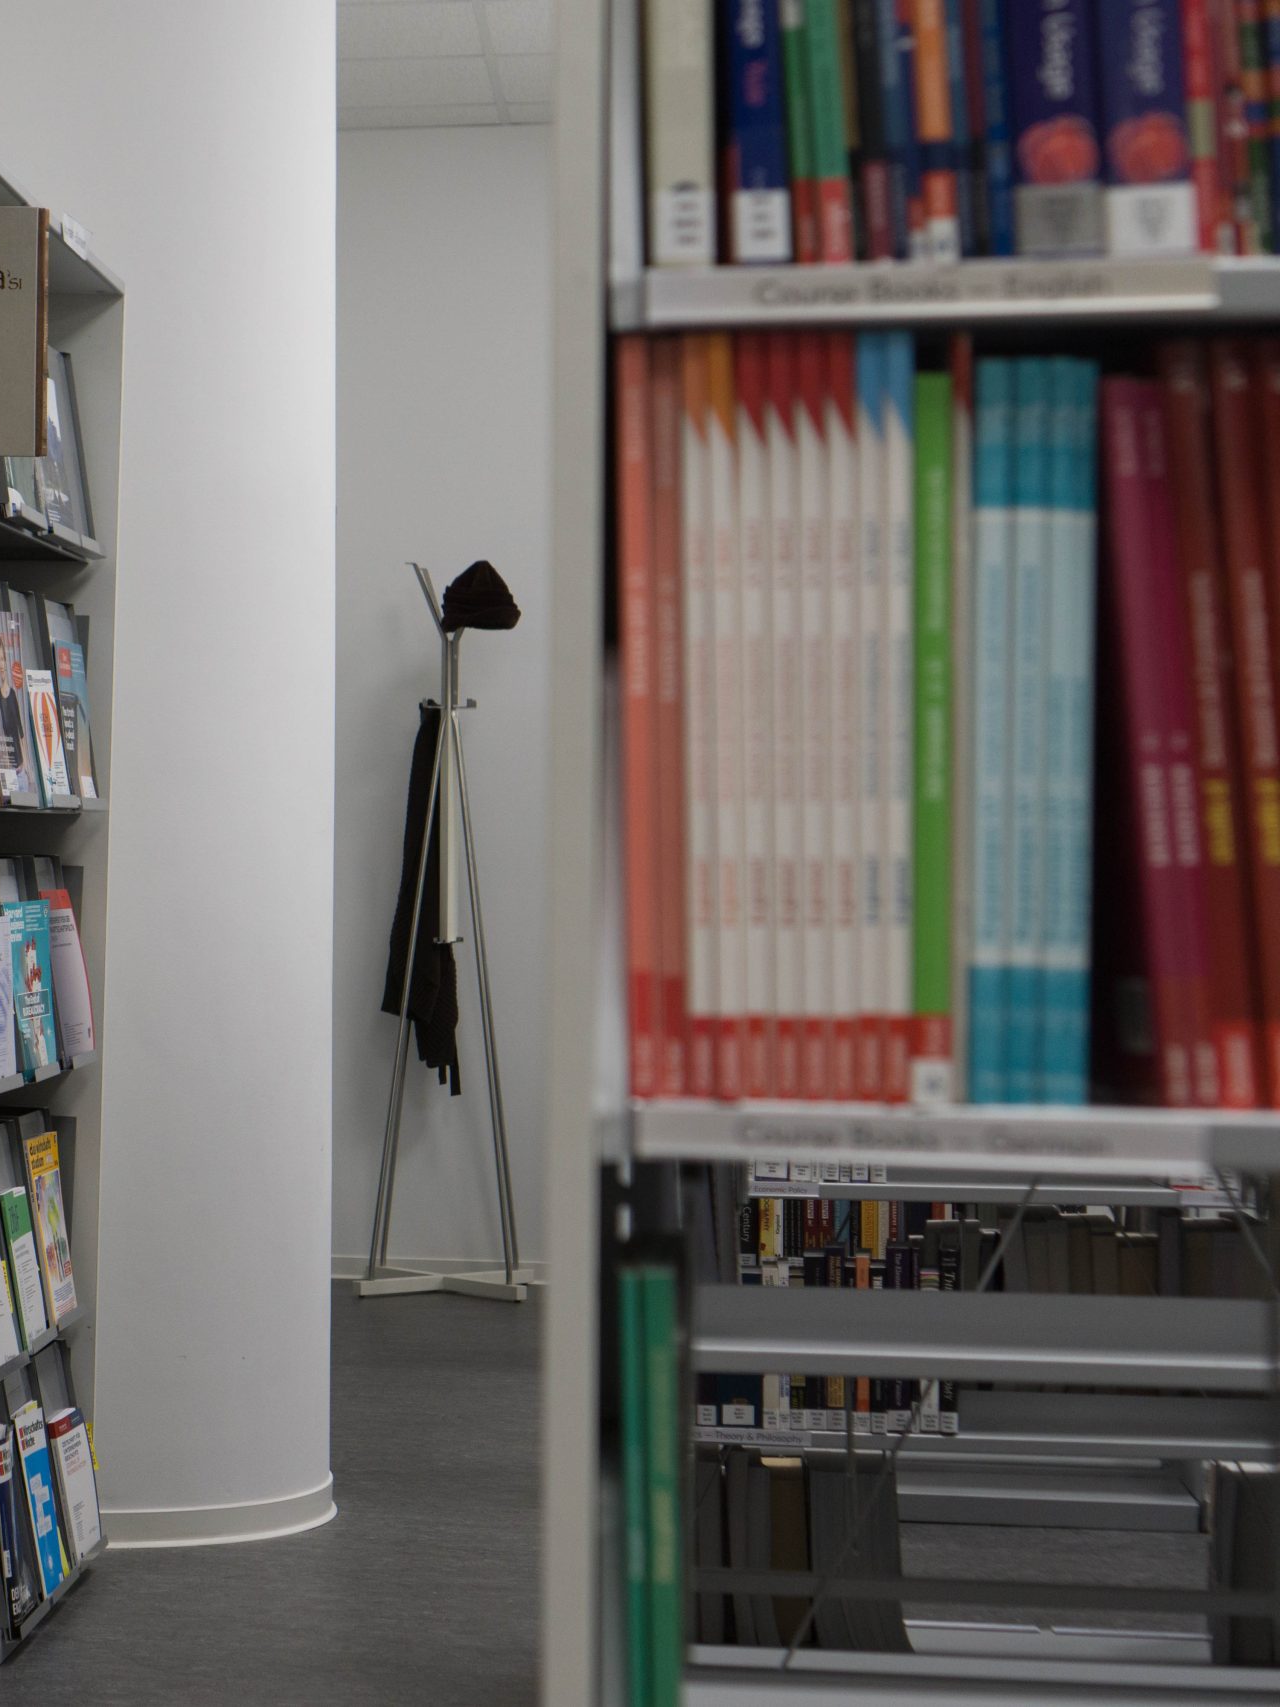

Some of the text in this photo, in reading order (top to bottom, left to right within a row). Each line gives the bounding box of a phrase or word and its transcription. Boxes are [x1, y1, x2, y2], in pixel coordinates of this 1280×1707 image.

[754, 1185, 808, 1194] Economic Policy
[740, 1207, 752, 1242] Century
[714, 1431, 746, 1442] Theory
[746, 1433, 755, 1442] &
[756, 1433, 804, 1444] Philosophy
